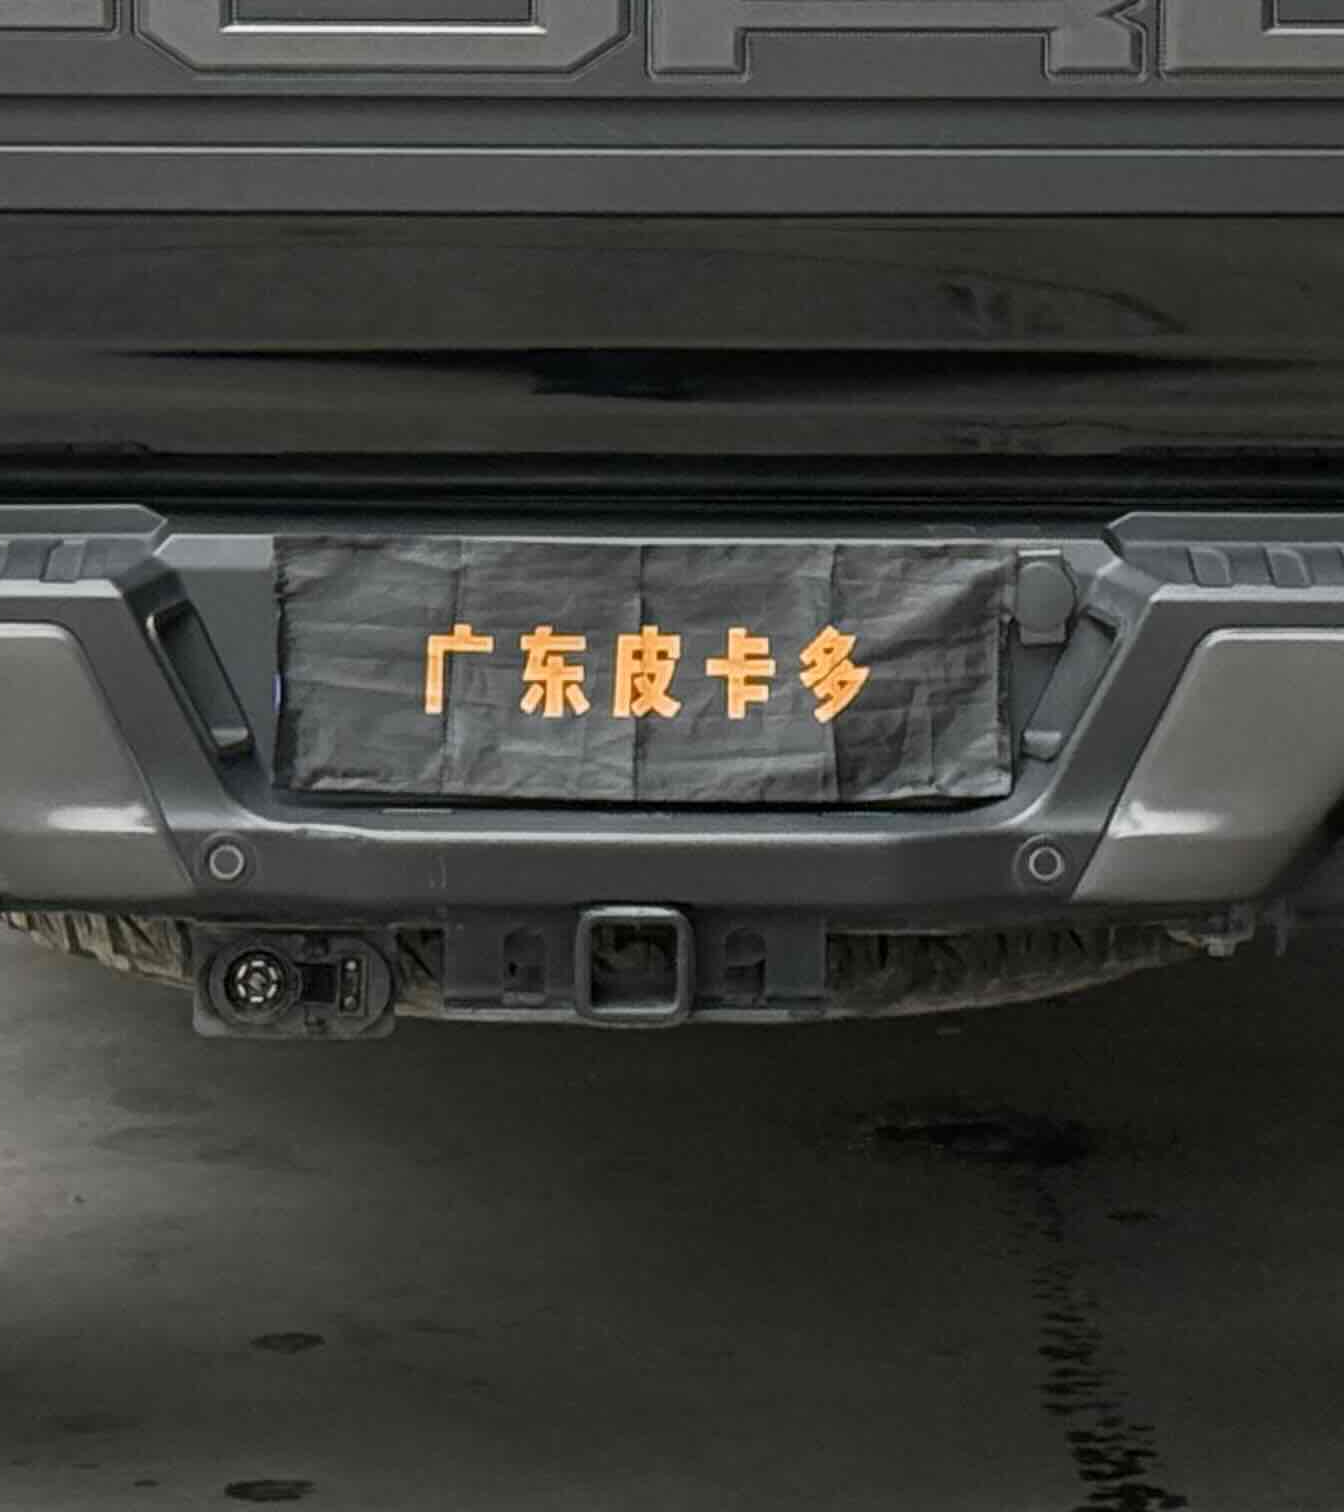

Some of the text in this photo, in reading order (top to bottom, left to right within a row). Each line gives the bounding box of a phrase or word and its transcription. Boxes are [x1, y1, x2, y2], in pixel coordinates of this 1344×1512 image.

[423, 624, 871, 724] 广东皮卡多
